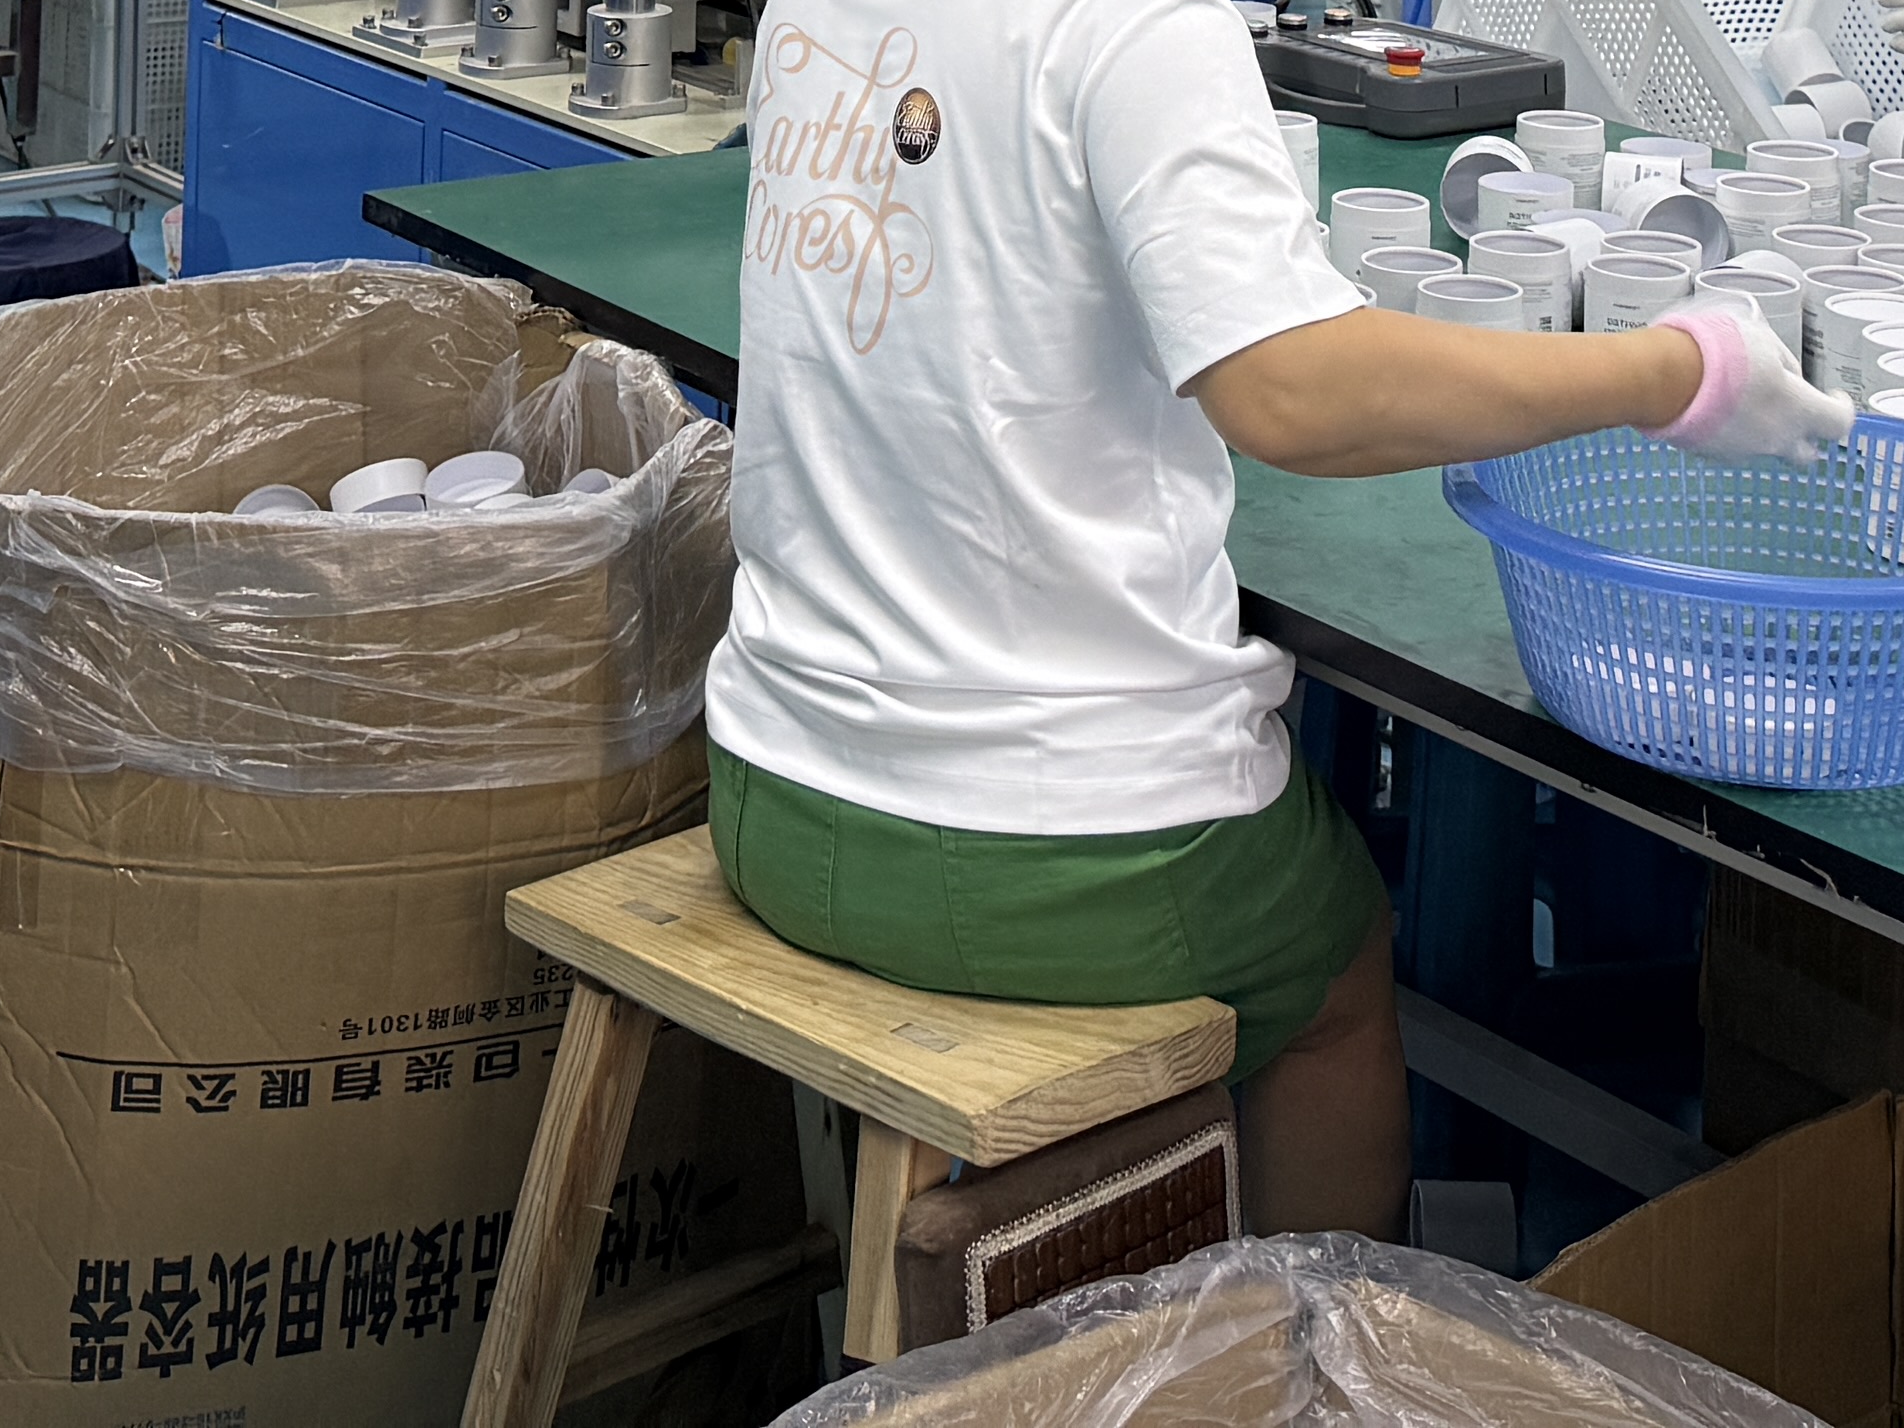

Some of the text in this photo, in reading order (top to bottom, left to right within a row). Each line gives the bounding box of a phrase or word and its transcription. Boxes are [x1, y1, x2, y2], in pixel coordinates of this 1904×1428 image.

[751, 22, 918, 214] Earthy
[111, 1040, 559, 1114] 包装有限公司
[68, 1159, 741, 1385] 一次性品接触用纸容器
